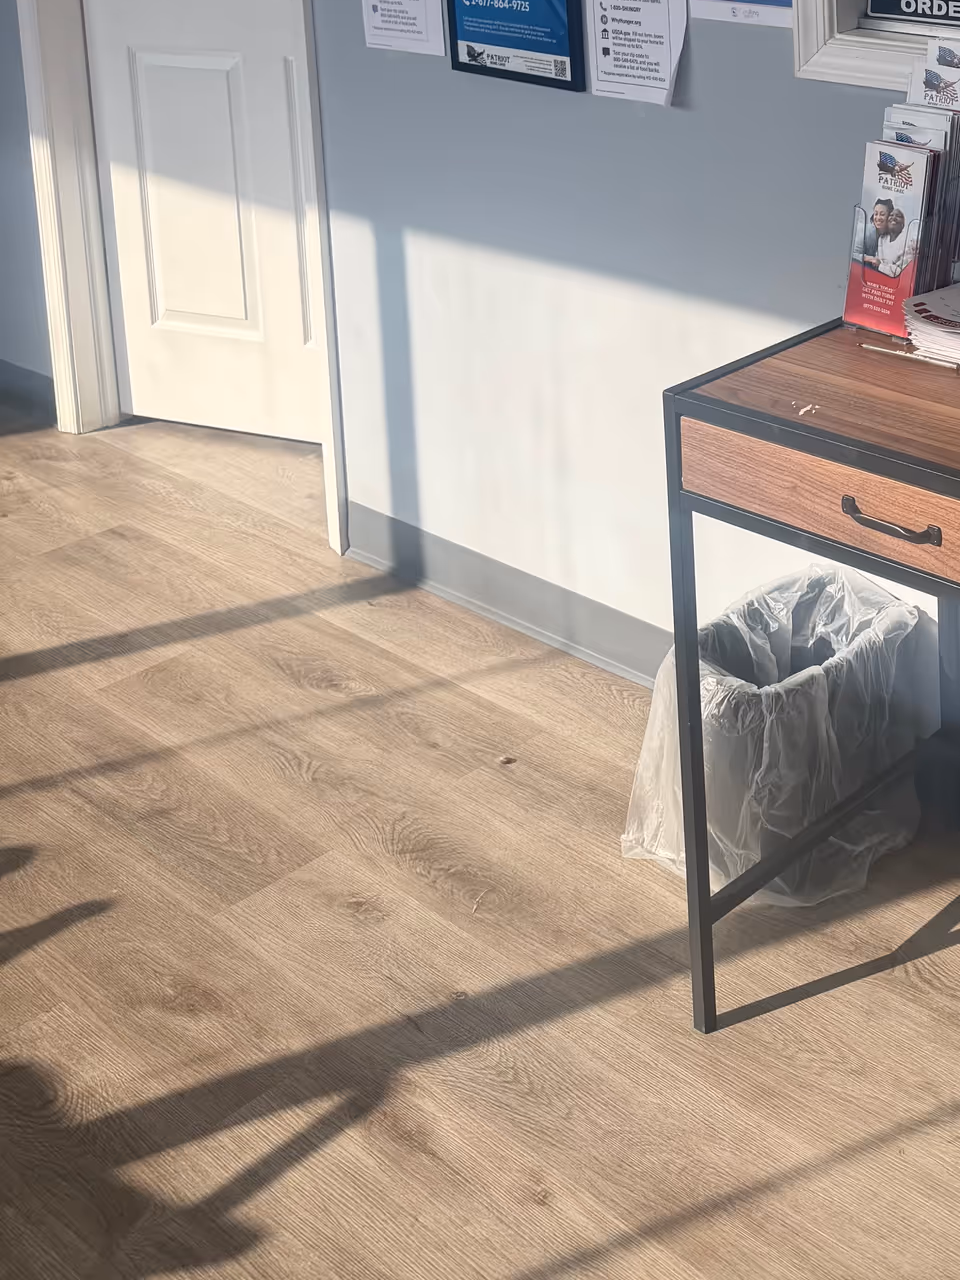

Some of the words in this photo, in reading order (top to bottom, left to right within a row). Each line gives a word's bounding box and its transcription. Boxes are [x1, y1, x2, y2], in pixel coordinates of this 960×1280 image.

[486, 53, 510, 64] PATRIOT
[924, 93, 954, 105] PATRIOT
[879, 176, 909, 189] PATRIOT
